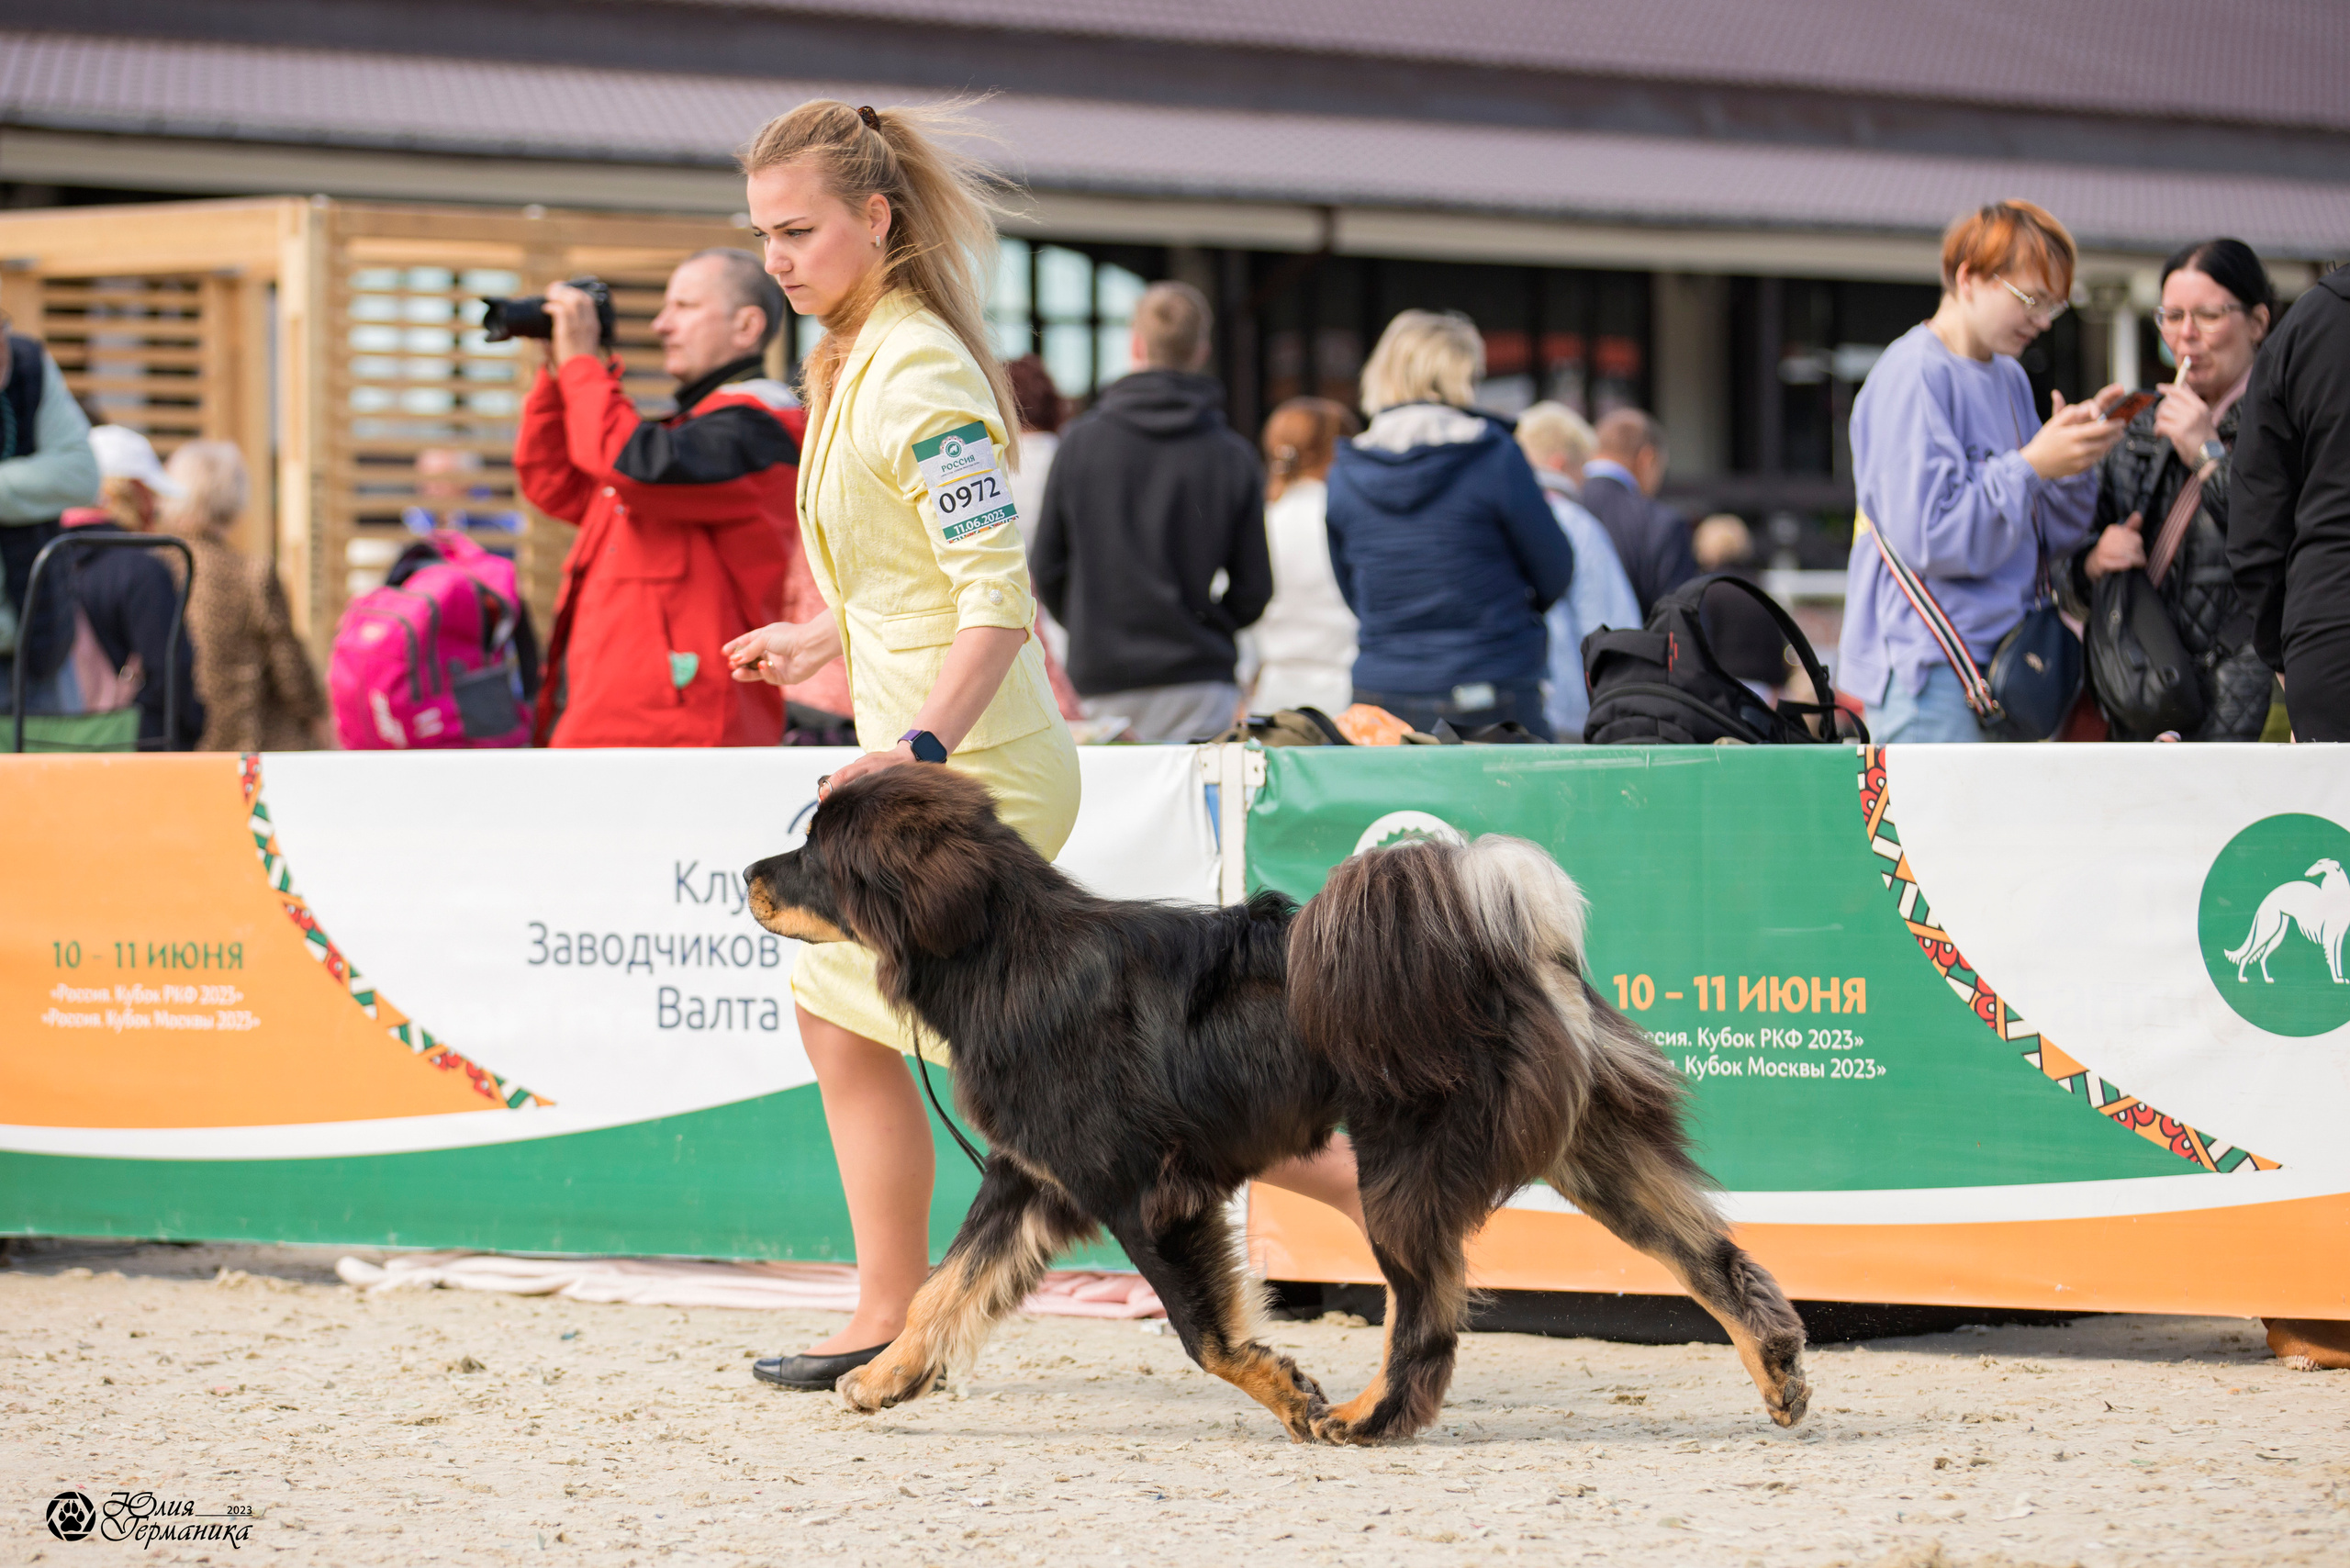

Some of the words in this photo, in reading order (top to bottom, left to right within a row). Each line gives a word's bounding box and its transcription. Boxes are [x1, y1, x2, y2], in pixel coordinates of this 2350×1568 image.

[941, 454, 976, 472] РОССИЯ
[939, 476, 1001, 514] 0972
[954, 510, 1005, 534] 11.06.2023
[675, 860, 747, 915] Клу
[53, 941, 81, 969] 10
[115, 942, 135, 969] 11
[527, 922, 780, 974] Заводчиков
[657, 986, 779, 1030] Валта
[1613, 974, 1655, 1011] 10
[1694, 975, 1726, 1012] 11
[1739, 976, 1866, 1014] ИЮНЯ
[1697, 1026, 1755, 1053] Кубок
[1760, 1028, 1803, 1048] РКФ
[1807, 1029, 1864, 1050] 2023»
[1684, 1055, 1743, 1081] Кубок
[1748, 1056, 1825, 1078] Москвы
[1830, 1058, 1886, 1079] 2023»
